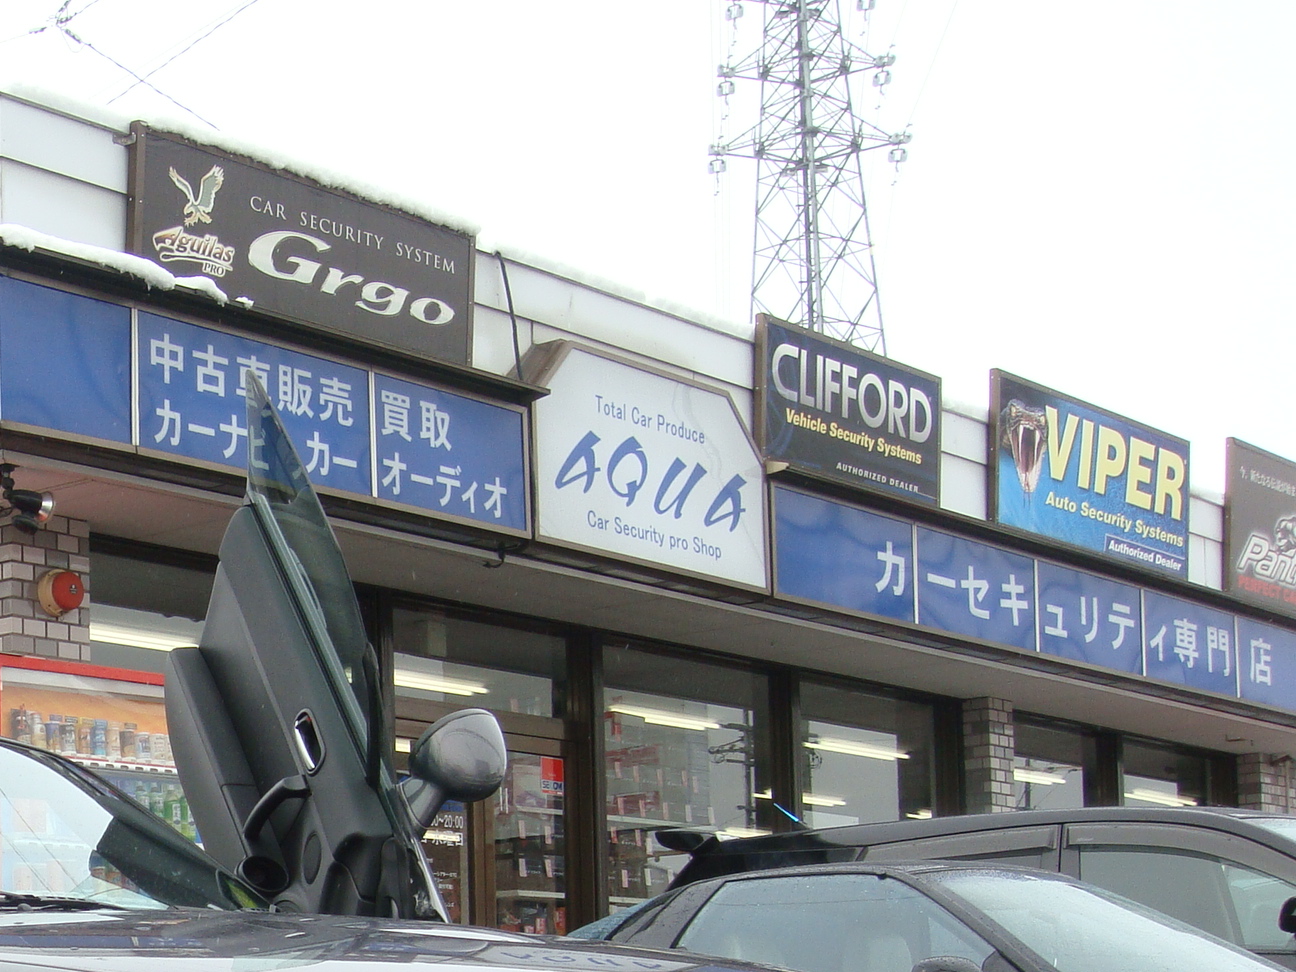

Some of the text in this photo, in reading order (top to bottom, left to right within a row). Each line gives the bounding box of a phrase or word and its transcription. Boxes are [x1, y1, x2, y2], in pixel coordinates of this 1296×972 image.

[152, 226, 235, 264] Aguilas
[249, 196, 456, 275] CAR SECURITY SYSTEM
[203, 262, 225, 276] PRO
[248, 230, 455, 326] Grgo
[150, 333, 452, 452] 中古車販売 買取
[595, 395, 705, 445] Total Car Produce
[771, 343, 933, 443] CLIFFORD
[785, 407, 923, 465] Vehicle Security Systems
[1045, 404, 1185, 521] VIPER
[554, 430, 748, 532] AQUA
[836, 461, 920, 493] AUTHORIZED DEALER
[587, 510, 722, 561] Car Security pro Shop
[1045, 491, 1184, 547] Auto Security Systems
[1108, 539, 1182, 571] Authorized Dealer
[1237, 534, 1296, 586] Pant
[874, 540, 1272, 687] カーセキュリティ専門店
[542, 780, 563, 791] SEOM
